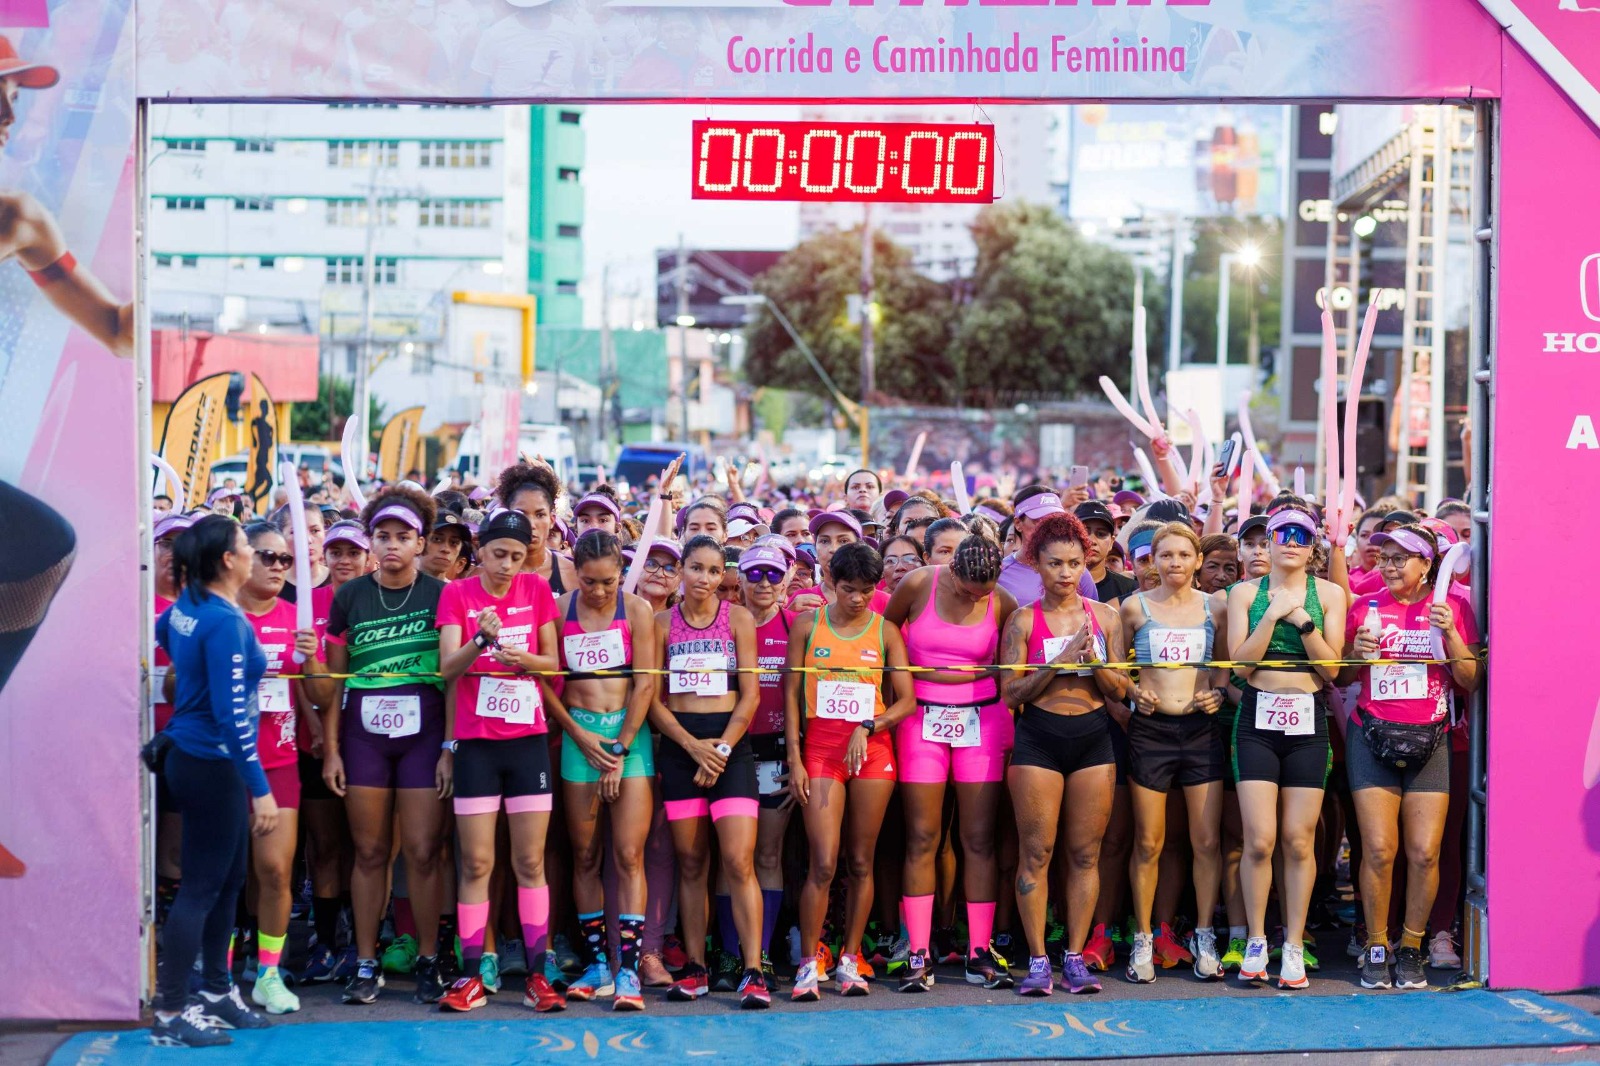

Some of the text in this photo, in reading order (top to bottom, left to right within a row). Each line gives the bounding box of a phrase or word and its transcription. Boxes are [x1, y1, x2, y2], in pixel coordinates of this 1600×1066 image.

[727, 32, 1185, 73] Corrida e Caminhada Feminina
[699, 128, 987, 194] 00:00:00
[354, 620, 427, 645] COELHO
[575, 648, 609, 667] 786
[1159, 646, 1190, 661] 431
[679, 672, 712, 688] 594
[1378, 679, 1409, 695] 611
[231, 653, 259, 762] ATLETISMO
[487, 696, 520, 714] 860
[825, 698, 860, 715] 350
[370, 713, 404, 728] 460
[1266, 710, 1300, 726] 736
[932, 722, 964, 738] 229
